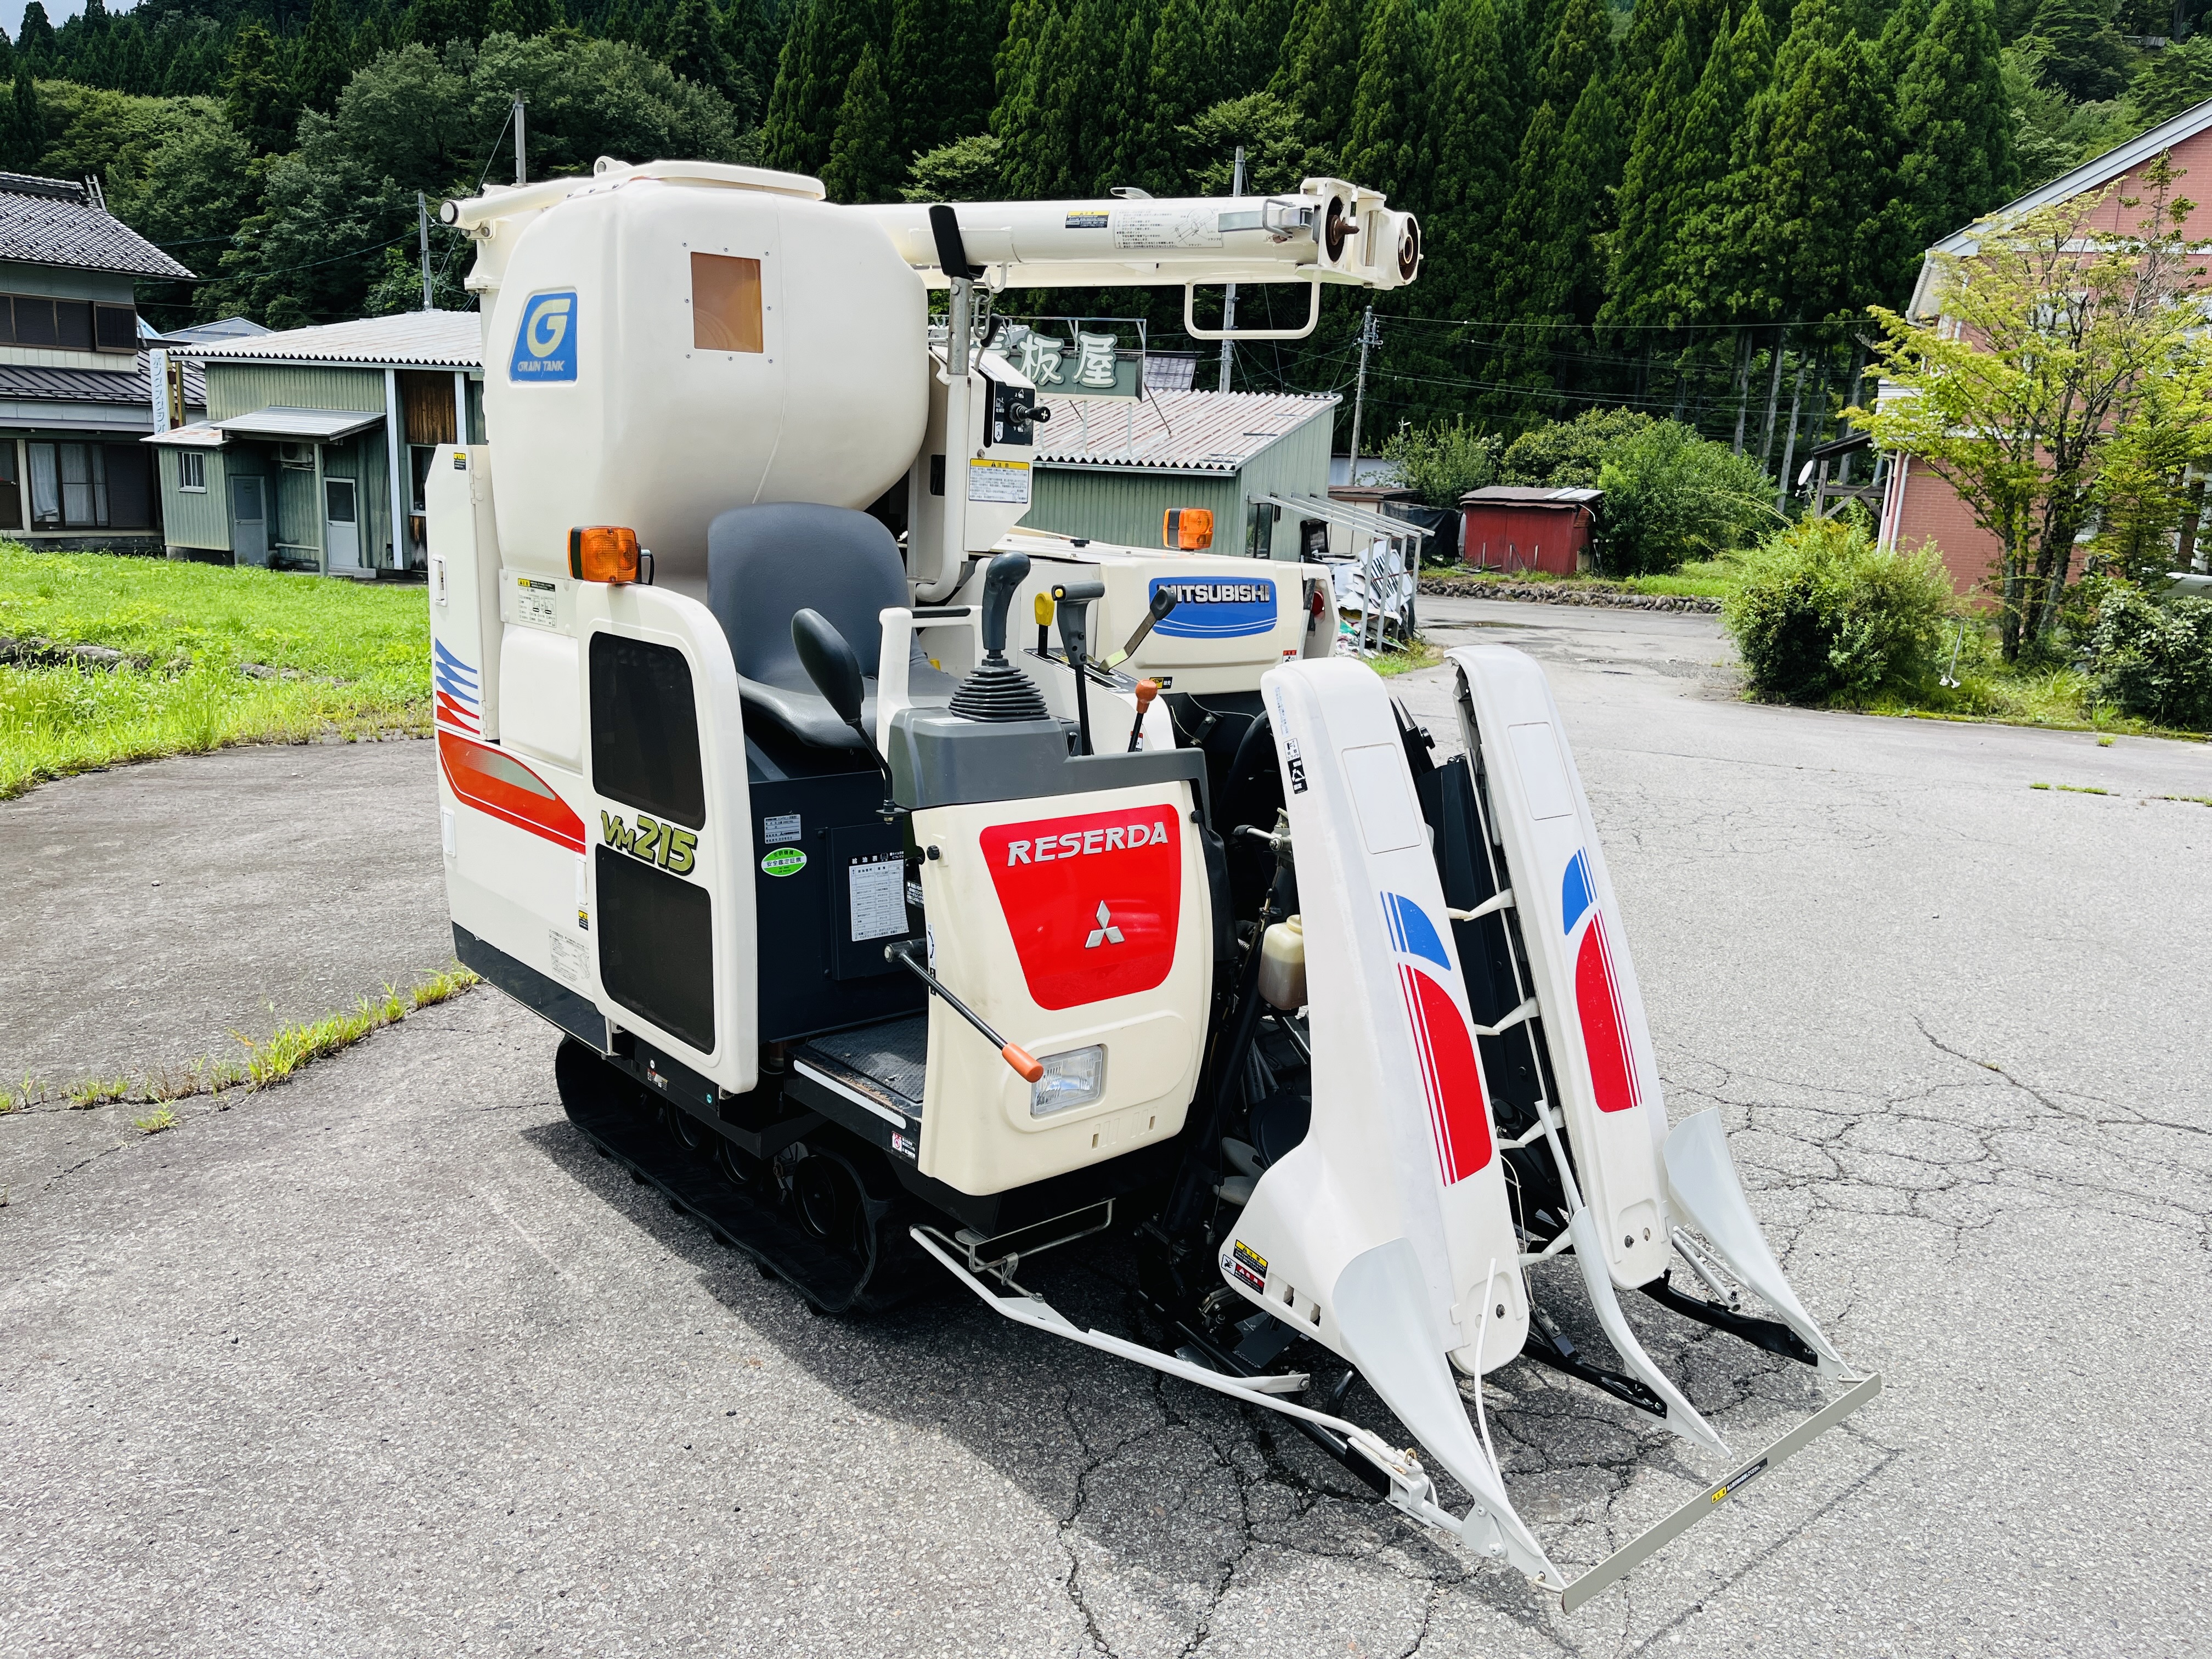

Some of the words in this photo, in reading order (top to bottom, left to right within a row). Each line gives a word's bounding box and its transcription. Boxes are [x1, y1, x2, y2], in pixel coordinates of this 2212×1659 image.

[527, 298, 571, 358] G
[517, 361, 540, 372] GRAIN
[543, 360, 565, 371] TANK
[1007, 822, 1168, 866] RESERDA
